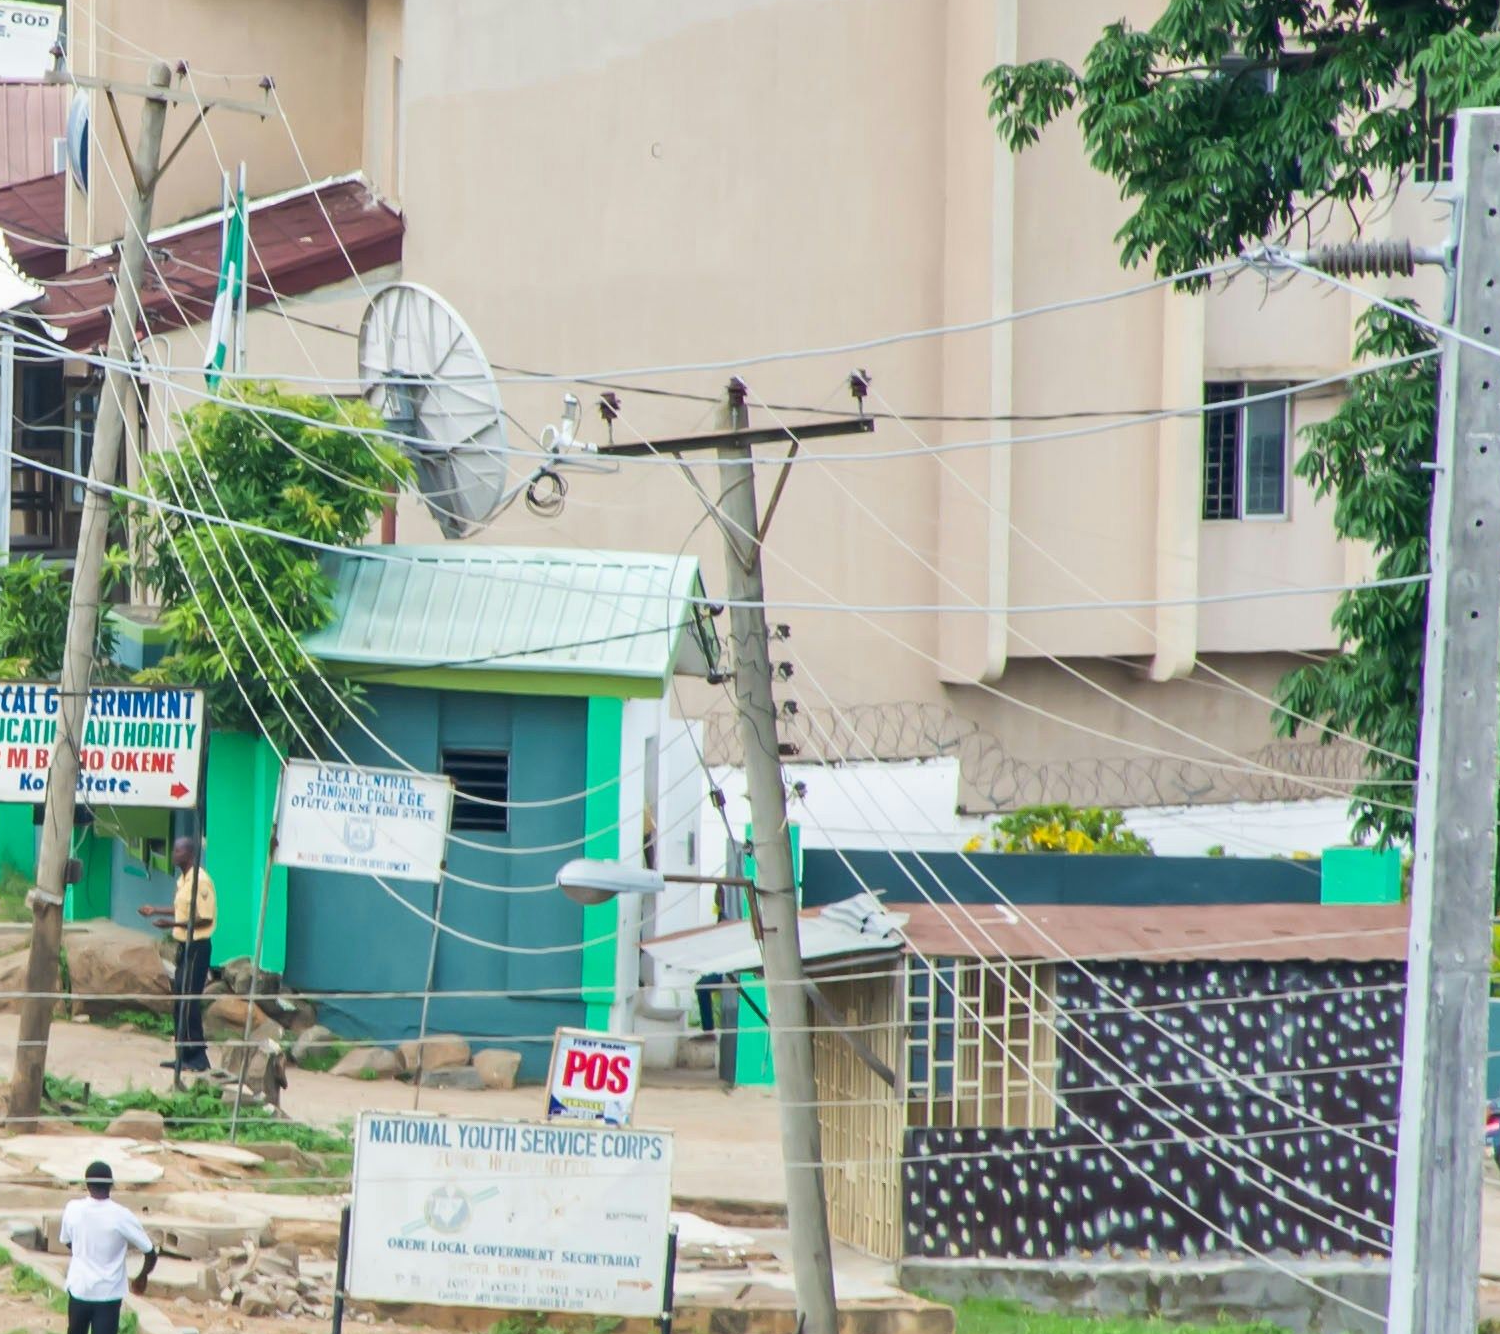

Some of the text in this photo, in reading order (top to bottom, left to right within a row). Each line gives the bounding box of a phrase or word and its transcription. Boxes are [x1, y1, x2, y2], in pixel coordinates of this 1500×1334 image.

[11, 11, 50, 28] GOD
[45, 685, 196, 720] GERNMENT
[83, 720, 198, 750] AUTHORITY
[111, 750, 176, 774] OKENE
[19, 772, 45, 792] Ko
[573, 1038, 598, 1049] FIRST
[562, 1049, 631, 1094] POS
[368, 1120, 664, 1162] NATIONAL YOUTH SERVICE CORPS
[387, 1237, 643, 1269] OKENE LOCAL GOVERNMENT SECRETARIAT
